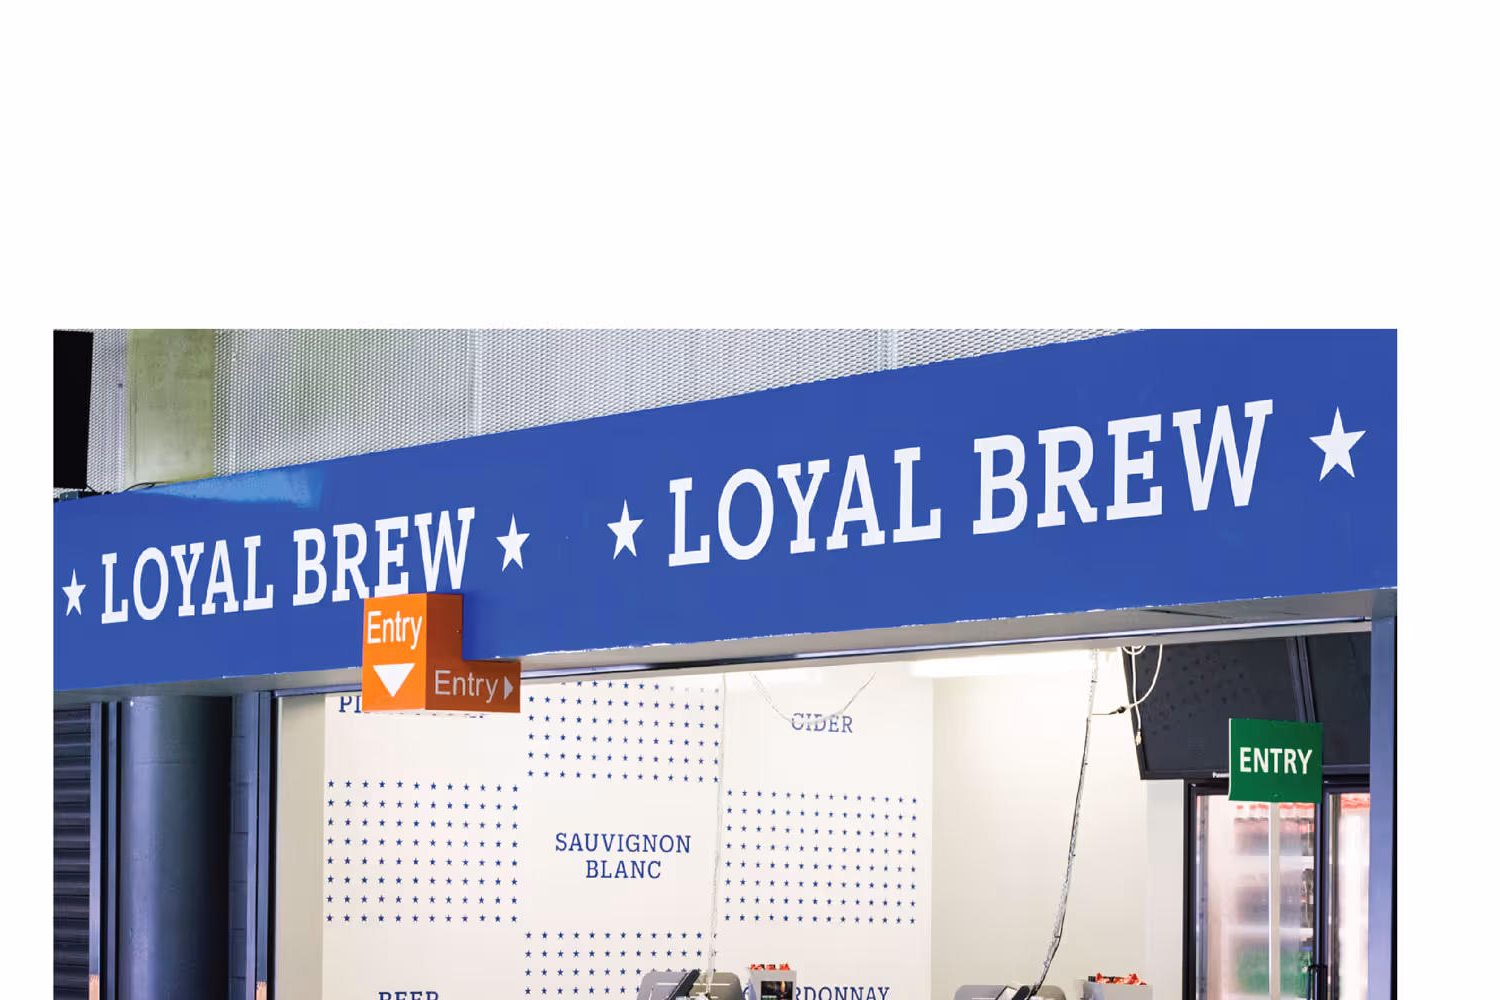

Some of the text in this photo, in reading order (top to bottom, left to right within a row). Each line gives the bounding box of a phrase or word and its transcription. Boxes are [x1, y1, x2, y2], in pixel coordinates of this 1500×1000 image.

[668, 399, 1274, 567] LOYAL BREW
[101, 507, 475, 624] LOYAL BREW
[367, 610, 423, 650] Entry
[435, 669, 499, 704] Entry
[791, 712, 853, 734] CIDER
[1239, 746, 1313, 775] ENTRY
[555, 832, 692, 853] SAUVIGNON
[585, 860, 661, 879] BLANC
